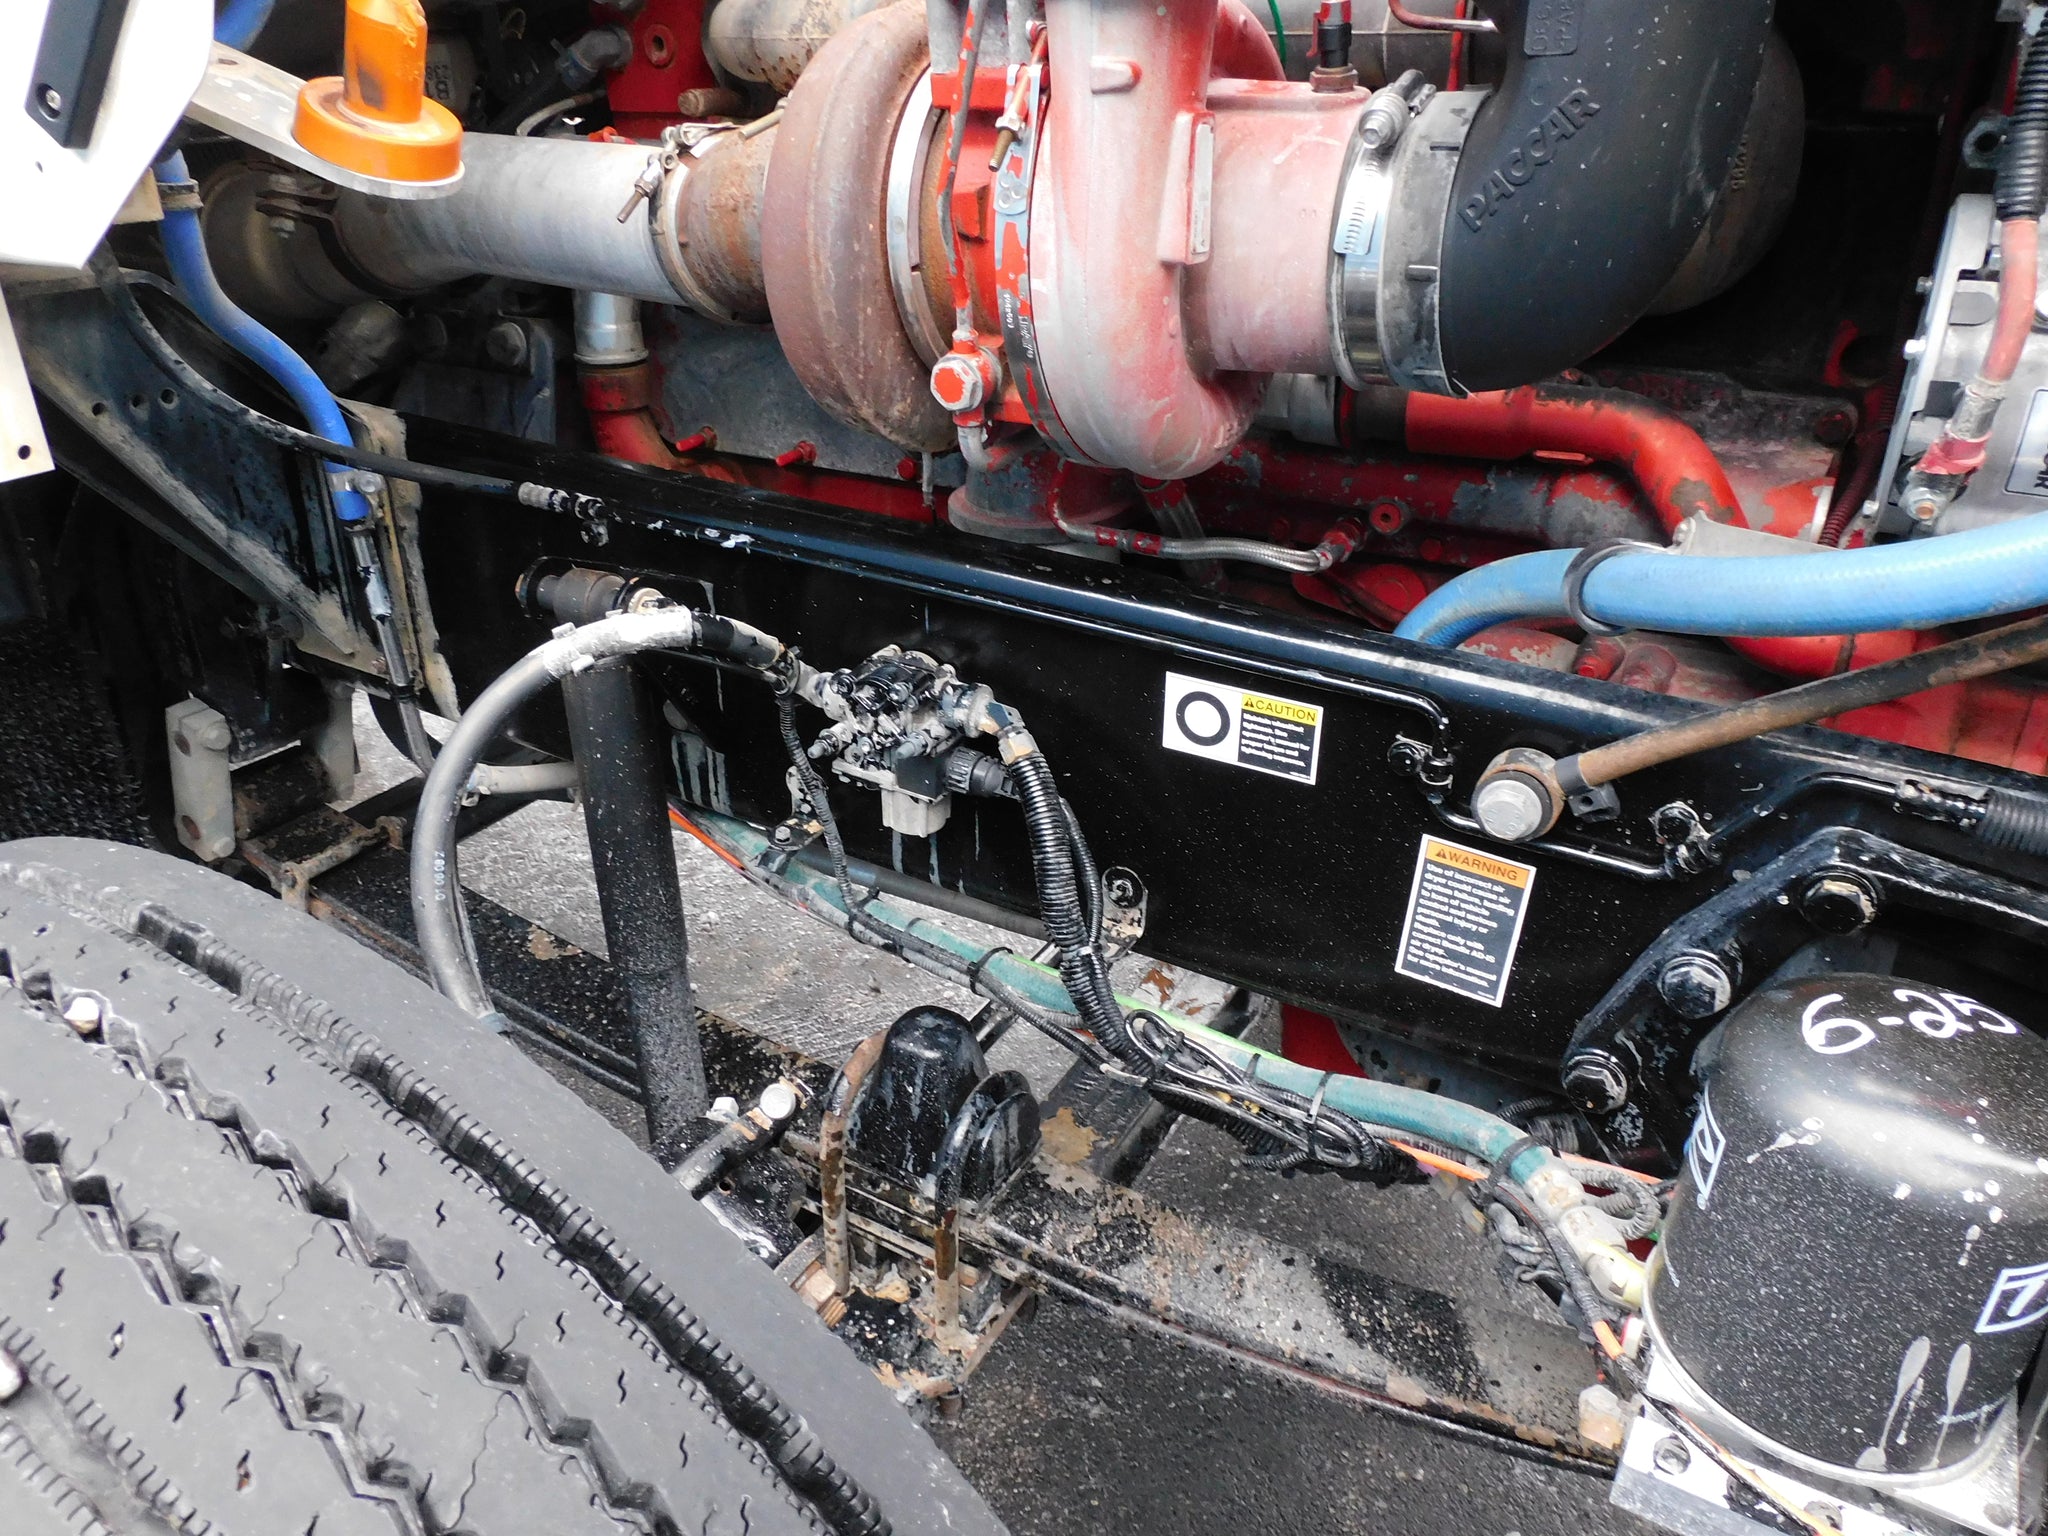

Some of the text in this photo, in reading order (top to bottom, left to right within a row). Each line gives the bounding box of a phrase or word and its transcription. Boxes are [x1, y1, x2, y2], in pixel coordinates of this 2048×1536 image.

[1457, 87, 1601, 233] PACCAR
[1256, 700, 1315, 722] CAUTION
[1450, 853, 1517, 880] WARNING
[1801, 989, 2017, 1055] 6-25
